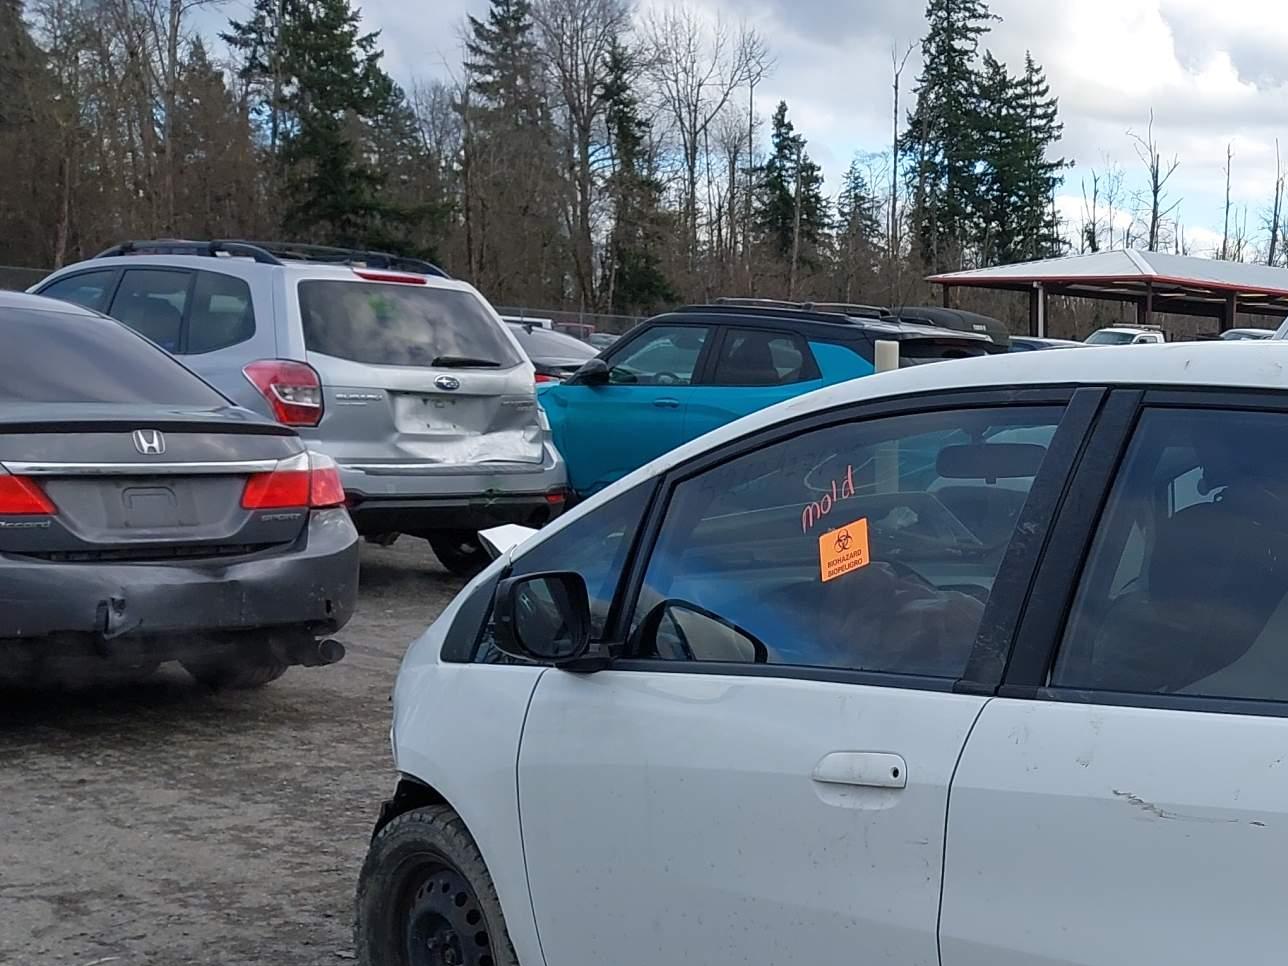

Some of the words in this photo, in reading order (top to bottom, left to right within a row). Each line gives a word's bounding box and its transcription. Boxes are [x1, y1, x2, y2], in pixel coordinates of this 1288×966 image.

[801, 464, 855, 534] mold
[827, 548, 862, 569] BIOHAZARD
[827, 557, 863, 578] BIOPELIGRO
